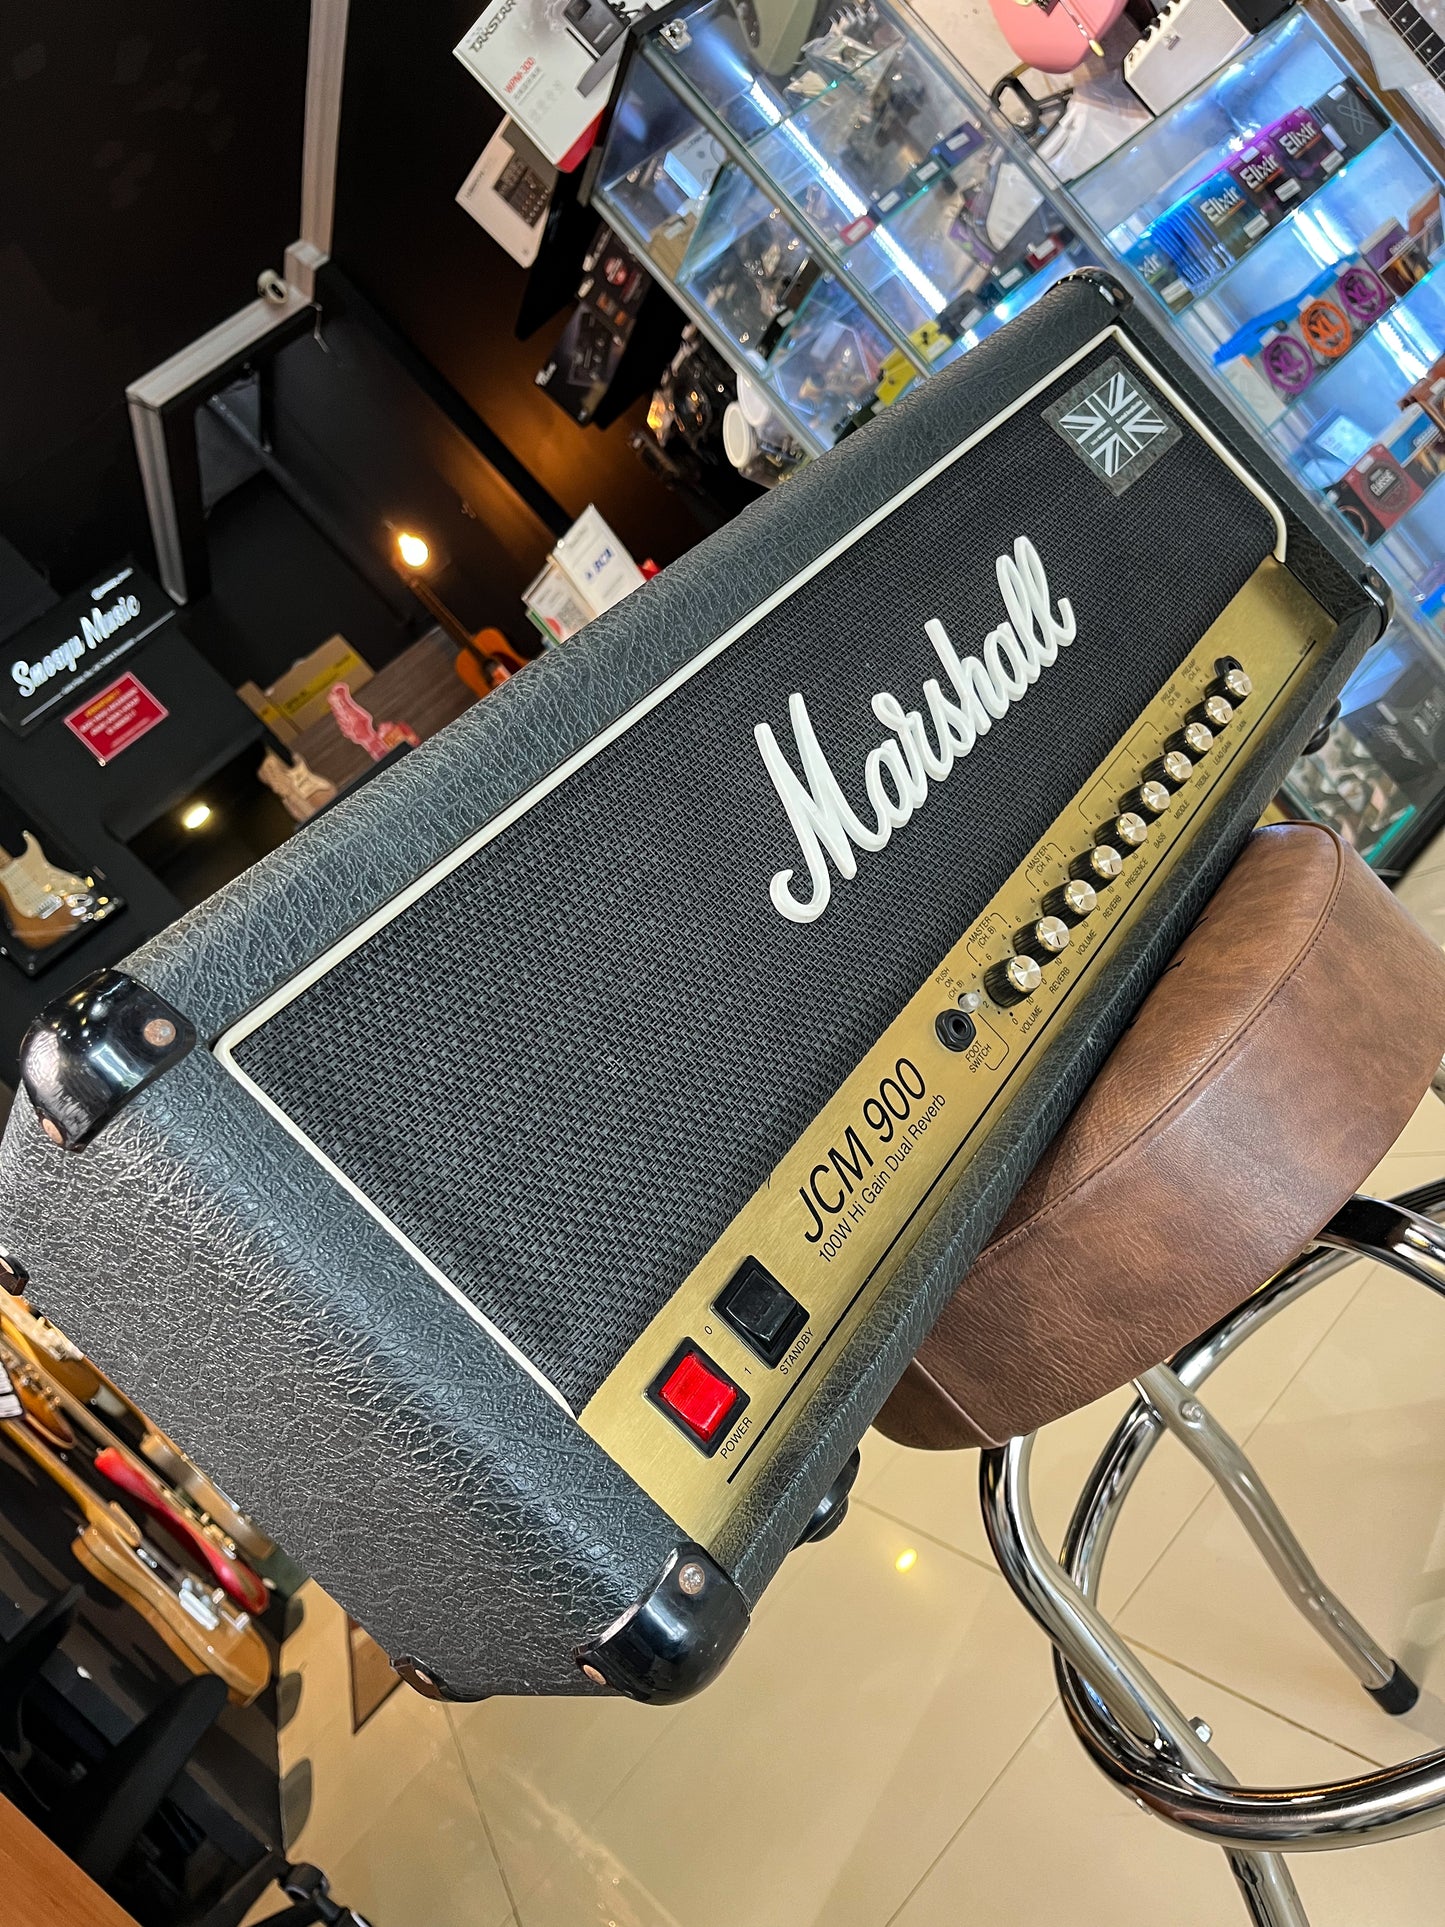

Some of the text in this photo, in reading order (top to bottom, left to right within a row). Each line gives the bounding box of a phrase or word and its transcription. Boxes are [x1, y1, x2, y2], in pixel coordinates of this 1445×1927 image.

[468, 0, 517, 53] TAKSTAR
[1278, 120, 1320, 156] Elixir
[1239, 153, 1280, 191] Elixir
[1199, 185, 1243, 222] Elixir
[79, 594, 141, 650] Music
[754, 536, 1077, 923] Marshall
[1195, 771, 1211, 790] TREBLE
[1174, 801, 1190, 820] MIDDLE
[1154, 832, 1166, 849] BASS
[1027, 845, 1049, 871] MASTER
[1124, 857, 1149, 889] PRESENCE
[1102, 894, 1122, 920] REVERB
[968, 916, 992, 944] MASTER
[1081, 921, 1089, 930] 10
[1076, 929, 1097, 957] VOLUME
[935, 967, 950, 985] PUSH
[1055, 957, 1063, 967] 10
[944, 977, 954, 988] ON
[1049, 966, 1070, 995] REVERB
[982, 1001, 990, 1009] 2
[1026, 996, 1034, 1006] 10
[1012, 1018, 1019, 1026] 0
[1020, 1005, 1043, 1035] VOLUME
[965, 1040, 982, 1062] FOOT
[969, 1043, 992, 1074] SWITCH
[797, 1057, 927, 1245] JCM 900
[818, 1092, 947, 1264] 100W Hi Gain Dual Reverb
[704, 1325, 714, 1336] 0
[779, 1327, 816, 1376] STANDBY
[719, 1416, 754, 1460] POWER
